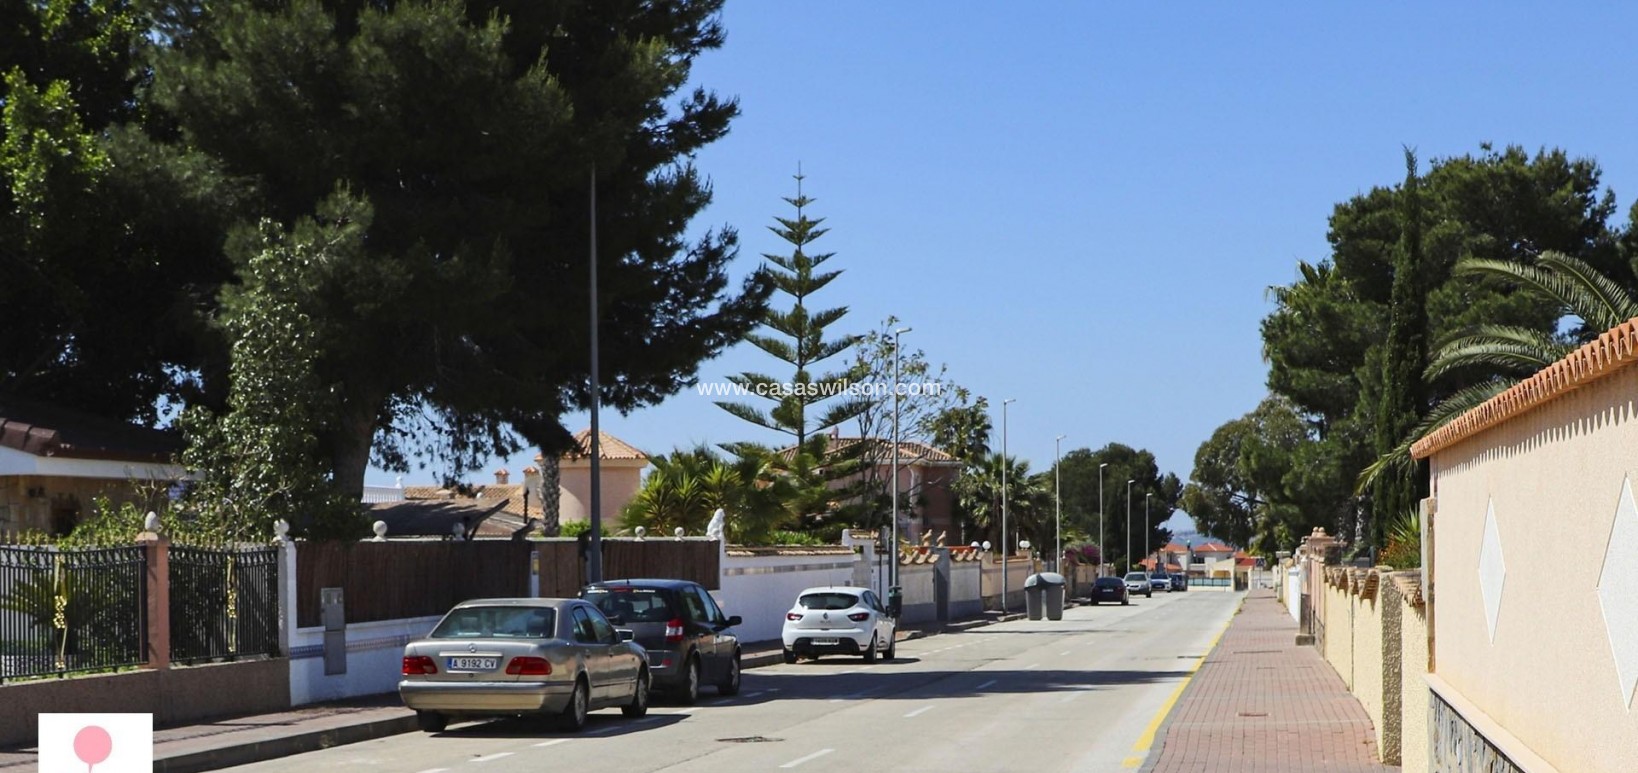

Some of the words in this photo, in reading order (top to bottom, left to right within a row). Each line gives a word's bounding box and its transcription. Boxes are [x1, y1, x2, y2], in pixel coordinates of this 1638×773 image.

[452, 659, 458, 668] A
[461, 659, 481, 668] 9192
[484, 659, 495, 668] CV
